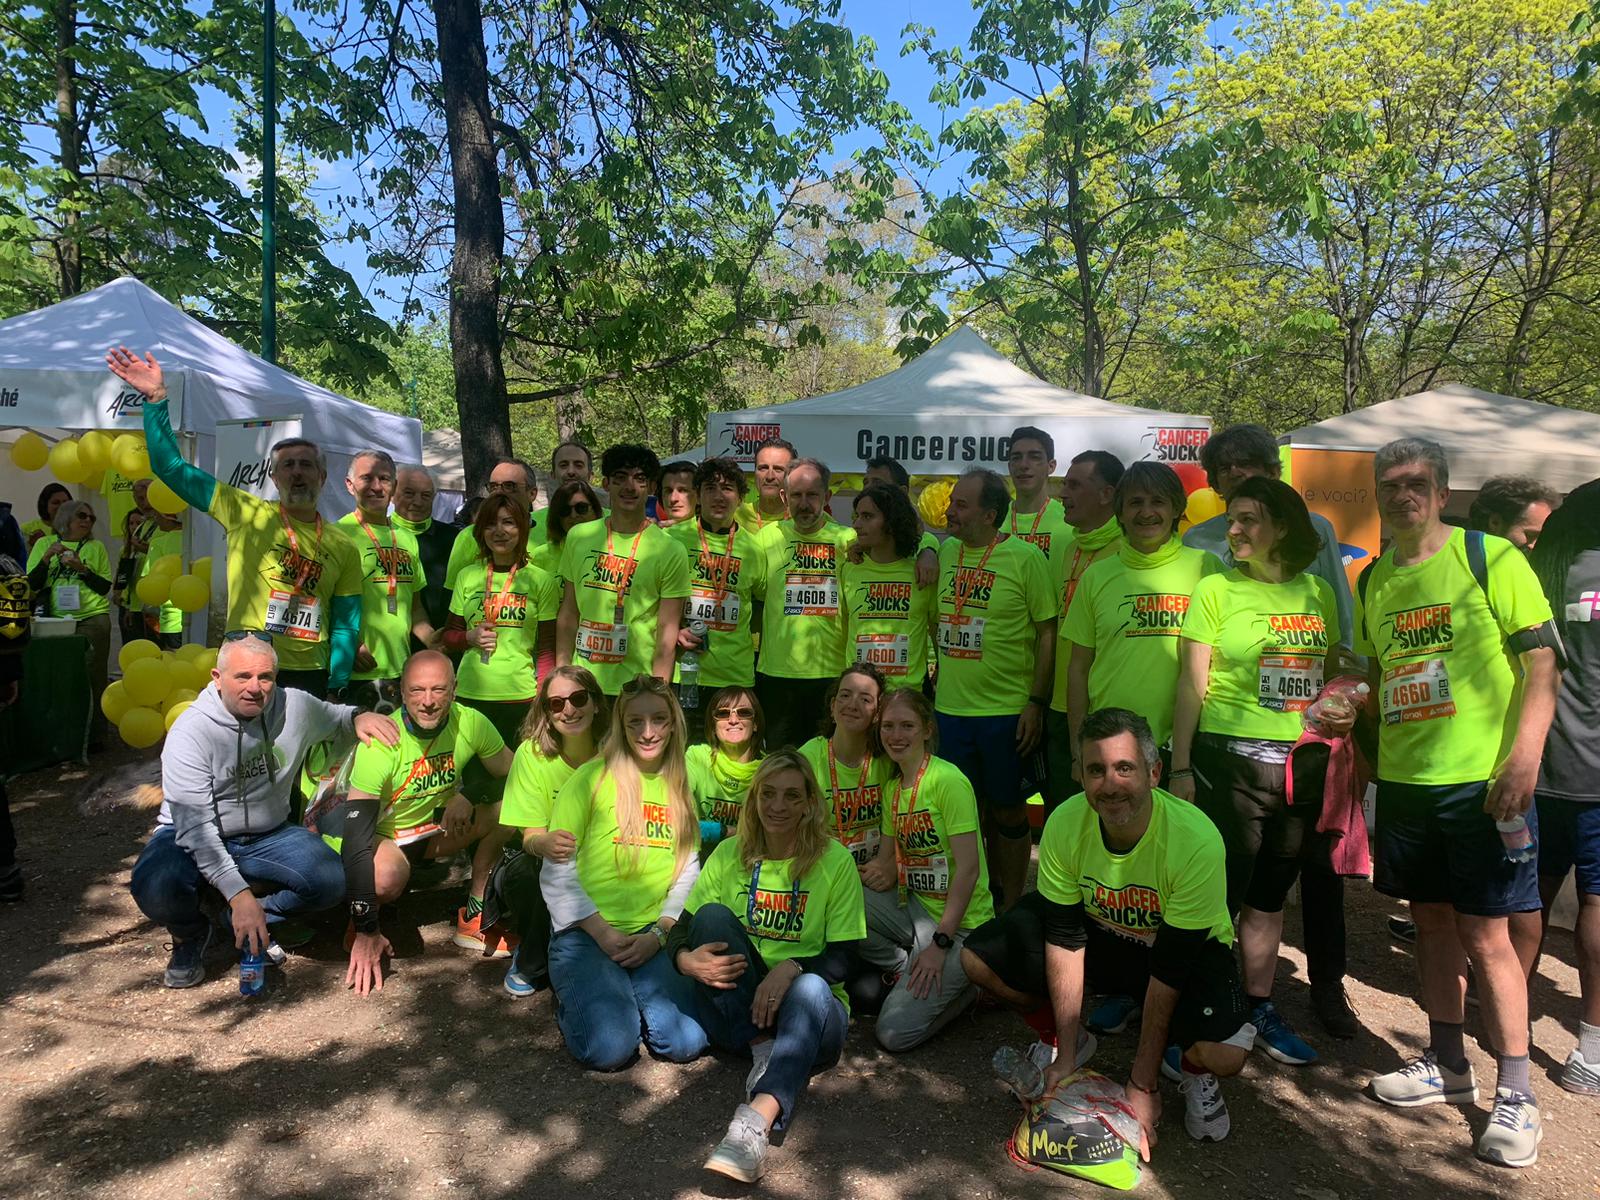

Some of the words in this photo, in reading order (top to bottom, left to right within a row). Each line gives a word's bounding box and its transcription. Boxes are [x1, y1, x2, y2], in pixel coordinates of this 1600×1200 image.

[0, 387, 19, 407] hé
[106, 391, 147, 419] ARC
[736, 426, 780, 441] CANCER
[1159, 429, 1208, 446] CANCER
[735, 440, 762, 455] SUC
[857, 429, 1011, 462] Cancersuc
[1159, 445, 1199, 461] SUCK
[228, 458, 272, 490] ARCH
[1322, 487, 1368, 503] voci?
[796, 543, 836, 560] CANCER
[282, 550, 323, 579] CCER
[597, 554, 638, 576] CANCR
[796, 555, 836, 570] SUCKS
[956, 567, 996, 588] ANCER
[486, 593, 528, 608] ANCER
[797, 590, 826, 605] 460B
[869, 583, 911, 599] CANCER
[868, 597, 910, 612] SUCKS
[1137, 595, 1189, 613] CANCER
[1271, 615, 1326, 632] CANCER
[1396, 605, 1452, 631] CANCER
[587, 635, 613, 652] 467D
[944, 630, 969, 648] 40C
[1275, 630, 1328, 647] SUCKS
[1398, 623, 1454, 650] SUCKS
[1278, 676, 1312, 697] 466C
[1393, 682, 1431, 707] 466D
[413, 768, 456, 793] SUCKS
[643, 804, 673, 824] NCER
[647, 820, 673, 840] CKS
[1095, 885, 1161, 913] CANCER
[753, 907, 804, 932] SUCKS
[1098, 904, 1162, 928] SUCKS
